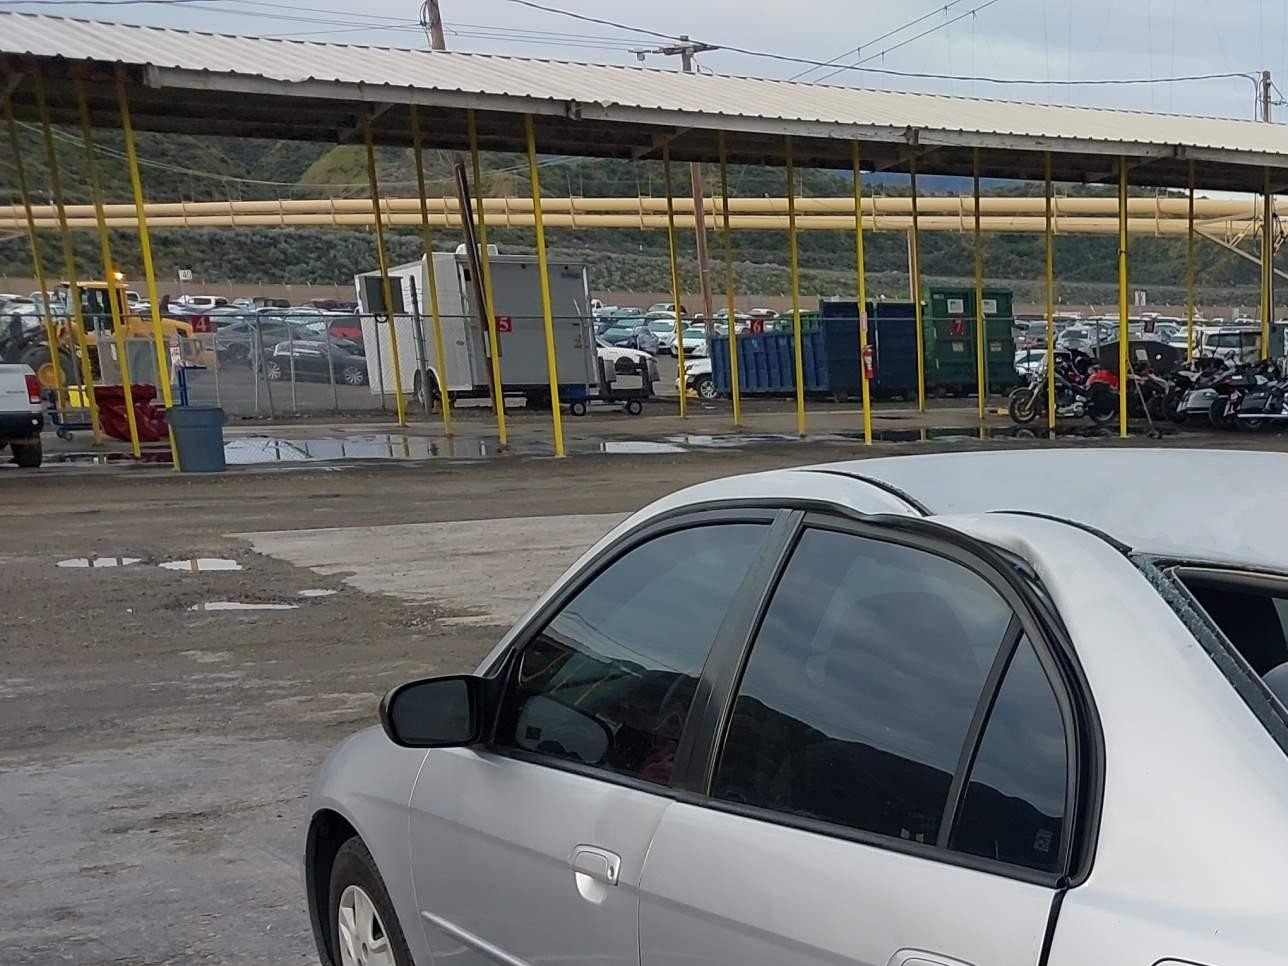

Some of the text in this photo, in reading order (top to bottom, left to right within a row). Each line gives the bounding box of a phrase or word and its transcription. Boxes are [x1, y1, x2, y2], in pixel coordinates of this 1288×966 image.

[197, 316, 207, 331] 4
[500, 317, 509, 331] 5
[753, 320, 761, 334] 6
[954, 319, 962, 333] 7
